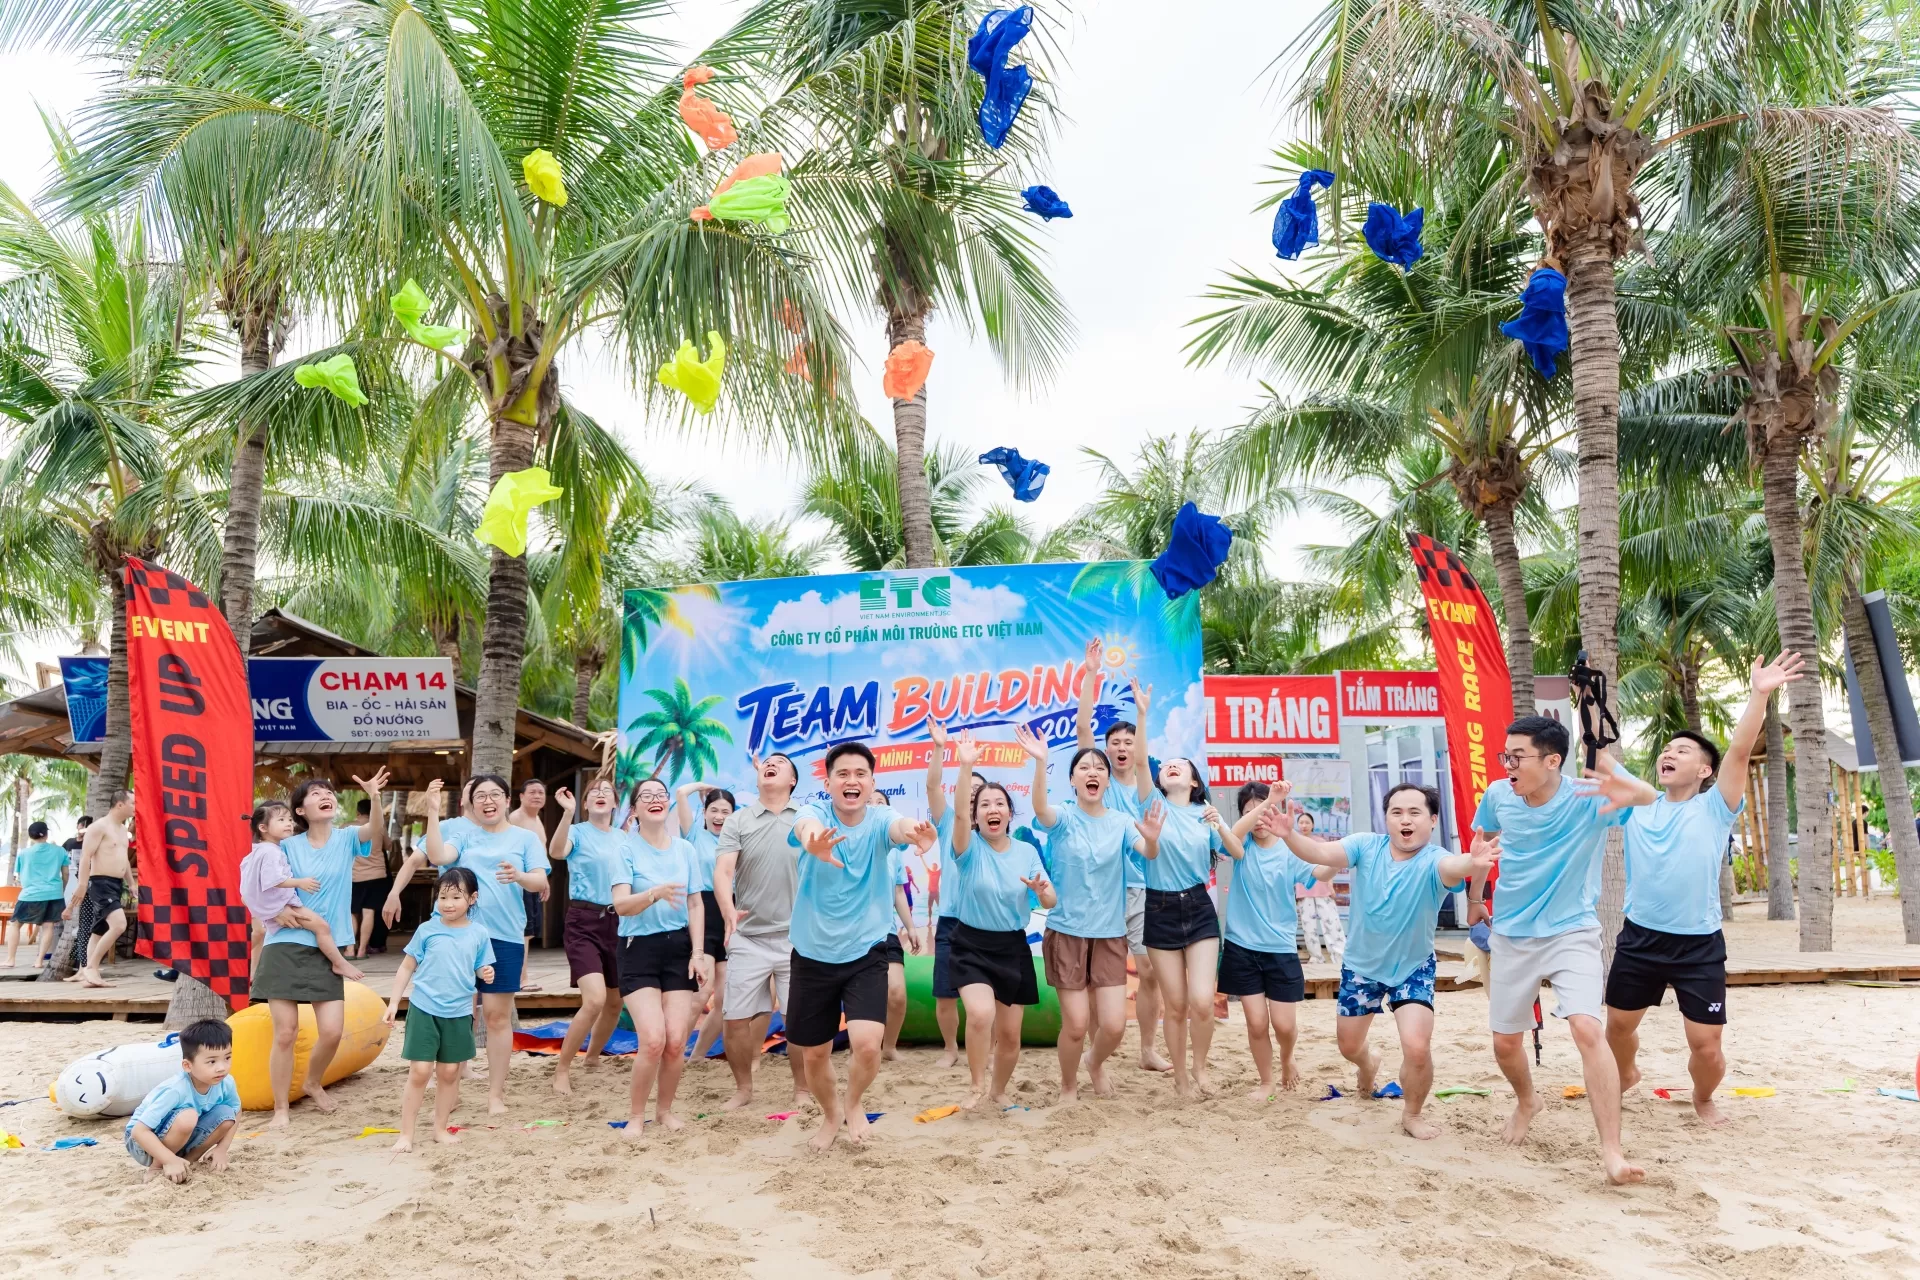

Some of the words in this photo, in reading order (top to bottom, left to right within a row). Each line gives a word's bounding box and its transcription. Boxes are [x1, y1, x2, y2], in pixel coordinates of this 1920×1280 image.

[860, 576, 951, 611] ETC
[132, 615, 210, 643] EVENT
[771, 630, 803, 646] CÔNG
[807, 631, 821, 645] TY
[824, 626, 842, 644] CỔ
[845, 625, 878, 642] PHẦN
[882, 624, 905, 641] MÔI
[909, 622, 958, 640] TRƯỜNG
[962, 624, 983, 638] ETC
[987, 620, 1012, 639] VIỆT
[1016, 622, 1043, 636] NAM
[158, 653, 206, 717] UP
[319, 672, 409, 697] CHẠM
[415, 672, 447, 691] 14
[1456, 637, 1482, 712] RACE
[326, 700, 348, 710] BIA
[361, 697, 381, 710] ỐC
[395, 698, 417, 710] HẢI
[420, 698, 446, 710] SẢN
[1345, 676, 1381, 712] TẮM
[1385, 681, 1438, 712] TRÁNG
[251, 697, 295, 720] NG
[377, 713, 424, 725] NƯỚNG
[737, 681, 881, 753] TEAM
[1225, 688, 1331, 739] TRÁNG
[260, 724, 277, 732] VIỆT
[375, 730, 399, 738] 0902
[880, 749, 913, 768] MÌNH
[994, 744, 1024, 763] TÌNH
[1224, 762, 1278, 782] TRÁNG
[1006, 781, 1030, 796] công
[161, 733, 210, 878] SPEED
